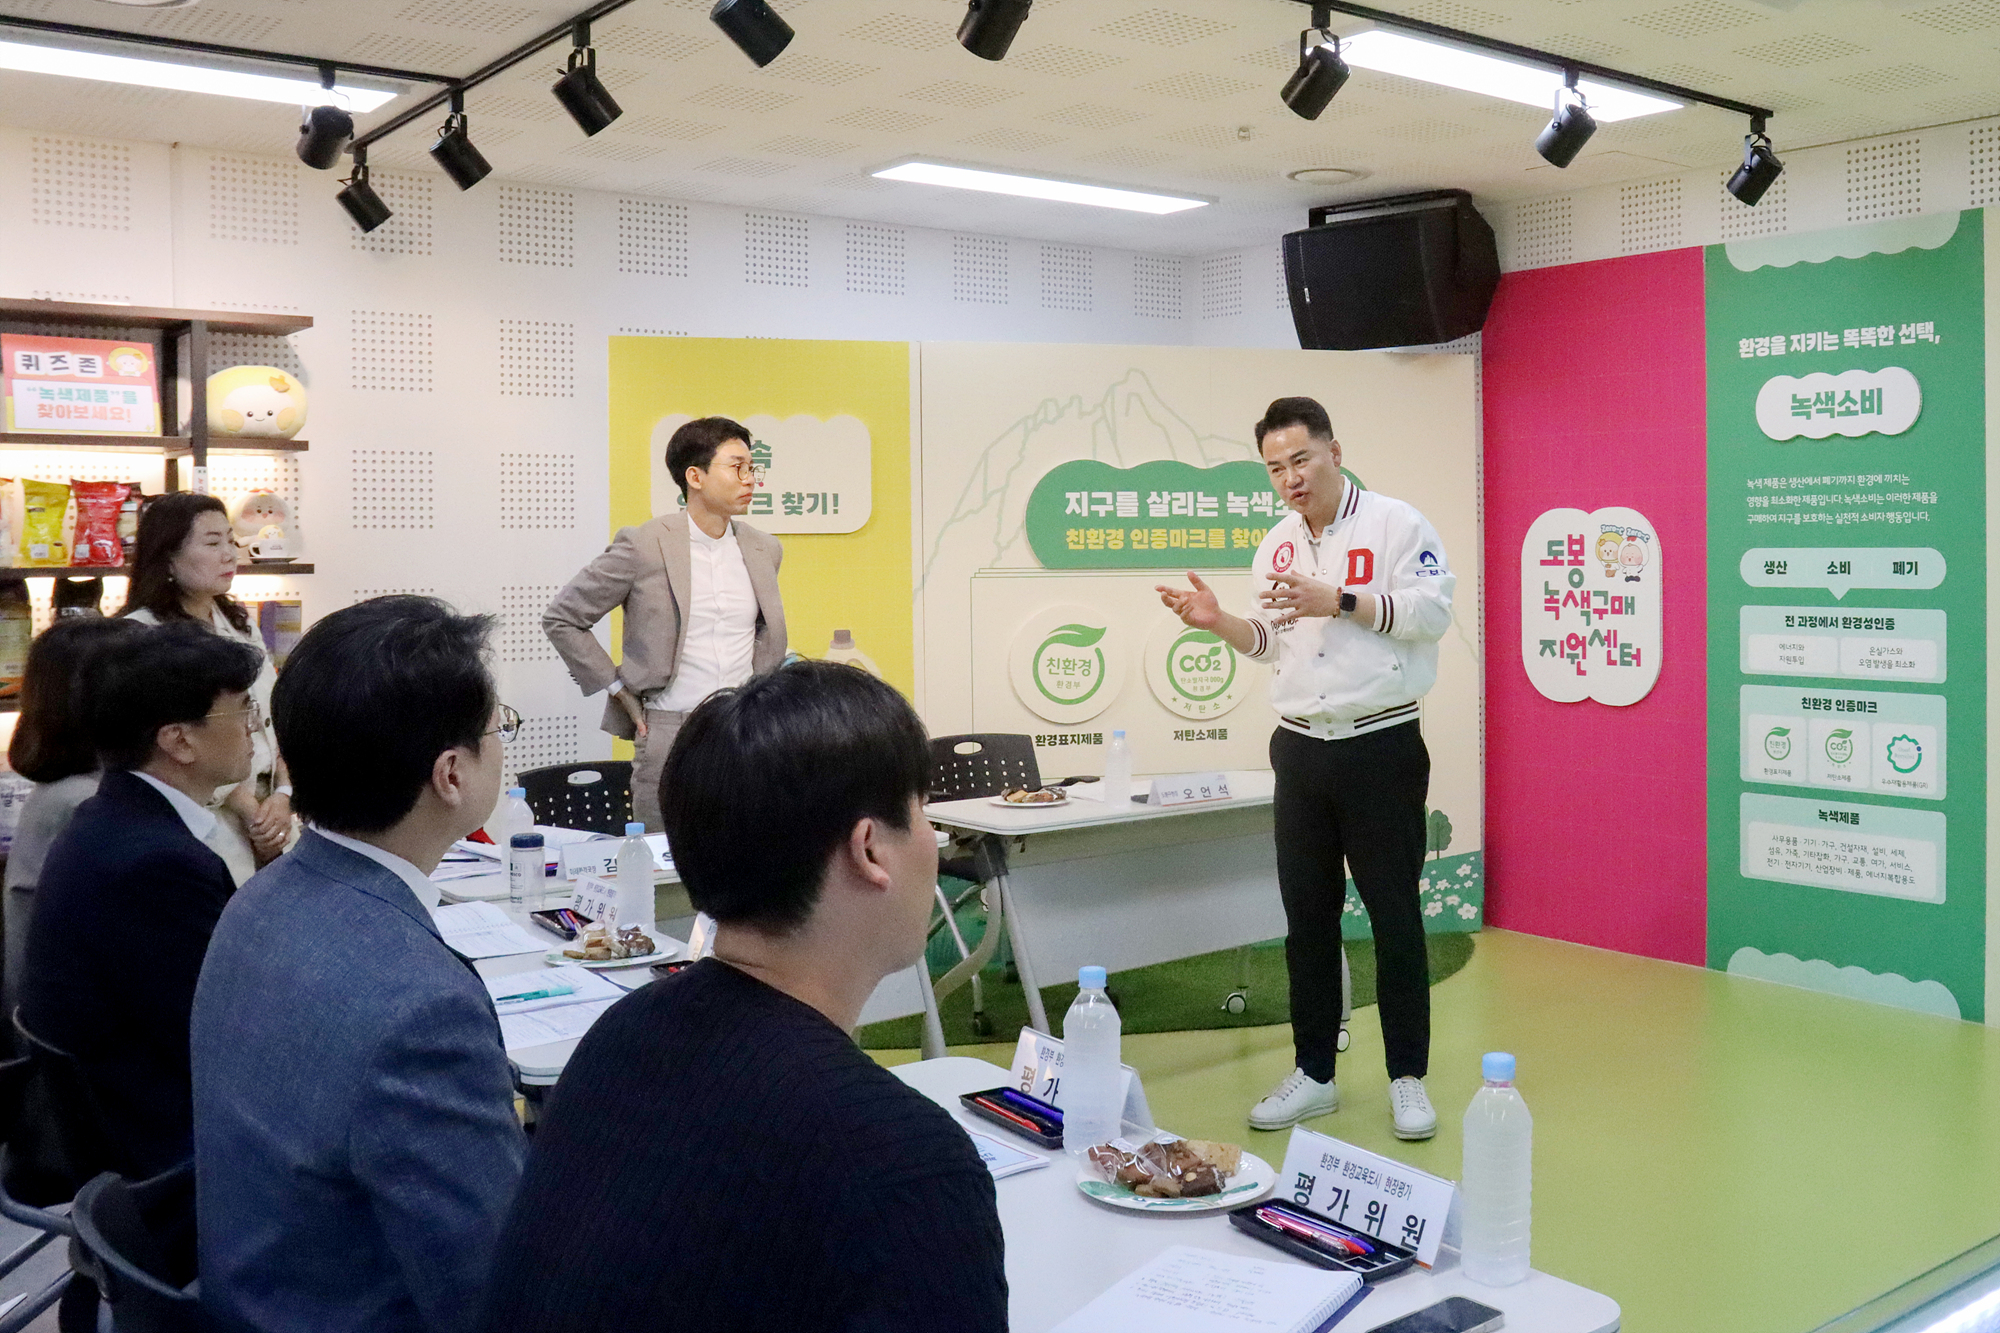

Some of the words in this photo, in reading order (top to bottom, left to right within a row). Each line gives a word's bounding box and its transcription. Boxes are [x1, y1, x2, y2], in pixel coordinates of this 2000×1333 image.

[1739, 335, 1787, 358] 환경을
[1790, 331, 1839, 352] 지키는
[1843, 325, 1895, 348] 똑똑한
[1898, 321, 1940, 344] 선택,
[1791, 388, 1883, 420] 녹색소비
[36, 403, 132, 423] 찾아보세요!
[1763, 477, 1788, 489] 제품은
[1789, 476, 1822, 488] 생산에서
[1822, 475, 1856, 486] 폐기까지
[1857, 474, 1883, 487] 환경에
[1884, 473, 1910, 485] 끼치는
[781, 492, 839, 515] 찾기!
[1065, 491, 1139, 517] 지구를
[1146, 491, 1219, 517] 살리는
[1746, 495, 1769, 507] 영향을
[1770, 495, 1801, 507] 최소화한
[1843, 493, 1884, 506] 녹색소비는
[1885, 492, 1911, 505] 이러한
[1911, 491, 1939, 504] 제품을
[1746, 513, 1777, 525] 구매하여
[1778, 513, 1801, 525] 지구를
[1802, 512, 1833, 525] 보호하는
[1834, 512, 1860, 525] 실천적
[1860, 511, 1885, 522] 소비자
[1885, 510, 1931, 524] 행동입니다.
[1066, 528, 1124, 550] 친환경
[1130, 528, 1226, 550] 인증마크를
[1345, 548, 1374, 586] D
[1540, 534, 1585, 588] 도봉
[1763, 560, 1787, 575] 생산
[1827, 561, 1851, 575] 소비
[1892, 561, 1918, 575] 폐기
[1544, 581, 1635, 626] 녹색구매
[1785, 615, 1795, 628] 전
[1797, 616, 1839, 628] 과정에서
[1841, 617, 1895, 630] 환경성인증
[1539, 629, 1641, 676] 지원센터
[1778, 643, 1805, 651] 에너지와
[1869, 646, 1904, 656] 온실가스와
[1046, 657, 1092, 677] 친환경
[1873, 660, 1893, 670] 발생을
[1894, 660, 1915, 669] 최소화
[1056, 680, 1081, 689] 환경부
[1801, 697, 1833, 711] 친환경
[1835, 699, 1878, 714] 인증마크
[1035, 732, 1103, 746] 환경표지제품
[1173, 729, 1228, 741] 저탄소제품
[1818, 809, 1860, 825] 녹색제품
[1772, 835, 1798, 846] 사무용품
[1803, 838, 1817, 847] 기기
[1766, 858, 1780, 867] 전기
[1815, 864, 1842, 875] 산업장비
[1320, 1152, 1341, 1172] 환경부
[1342, 1160, 1383, 1190] 환경교육도시
[1384, 1176, 1412, 1200] 현장평가
